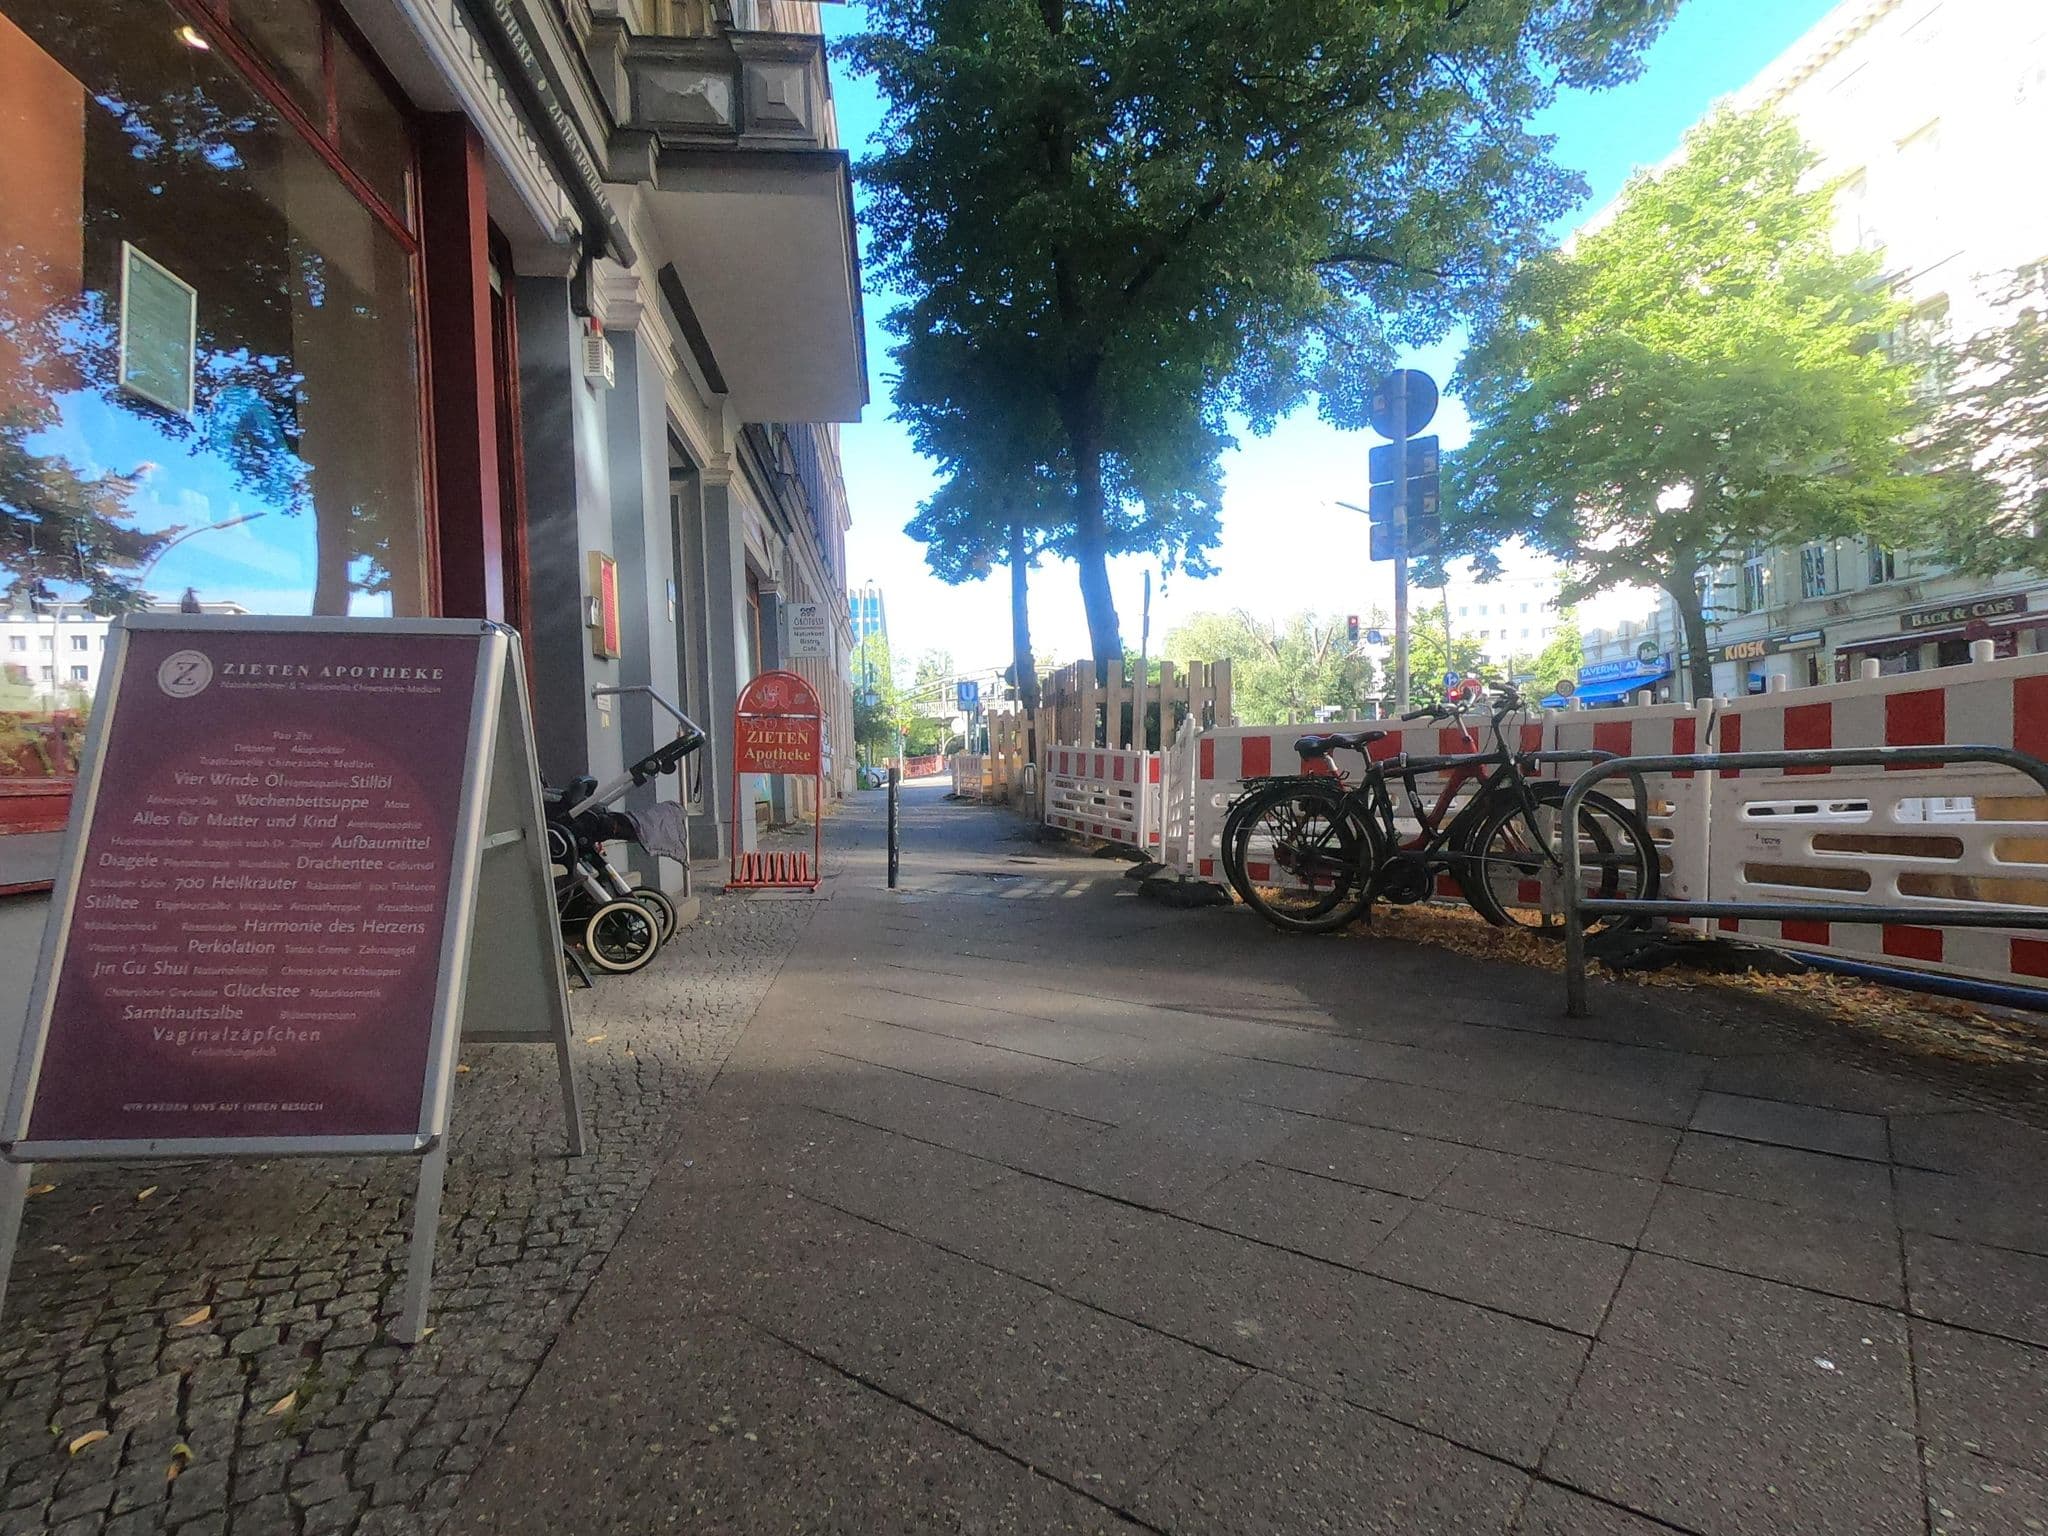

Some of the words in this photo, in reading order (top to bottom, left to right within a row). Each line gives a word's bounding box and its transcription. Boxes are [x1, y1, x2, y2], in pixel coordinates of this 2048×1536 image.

[1724, 640, 1766, 661] KIOSK
[222, 663, 310, 678] ZIETEN
[319, 665, 443, 680] APOTHEKE
[1580, 663, 1620, 677] TAVERNA
[961, 684, 976, 701] U
[746, 731, 809, 744] ZIETEN
[744, 748, 811, 762] Apotheke
[174, 772, 204, 786] Vier
[209, 773, 260, 787] Winde
[349, 774, 392, 789] Stillöl
[235, 793, 370, 811] Wochenbettsuppe
[132, 811, 171, 826] Alles
[177, 811, 200, 826] für
[206, 813, 259, 828] Mutter
[265, 813, 297, 828] und
[302, 813, 338, 829] Kind
[330, 834, 431, 850] Aufbaumittel
[296, 855, 384, 871] Drachentee
[174, 877, 205, 892] 700
[83, 893, 140, 910] Stilltee
[243, 919, 323, 934] Harmonie
[327, 917, 356, 934] des
[361, 919, 426, 934] Herzens
[188, 939, 276, 955] Perkolation
[121, 961, 147, 976] Gu
[222, 982, 301, 999] Glückstee
[122, 1004, 244, 1021] Samthautsalbe
[152, 1026, 322, 1046] Vaginalzäpfchen
